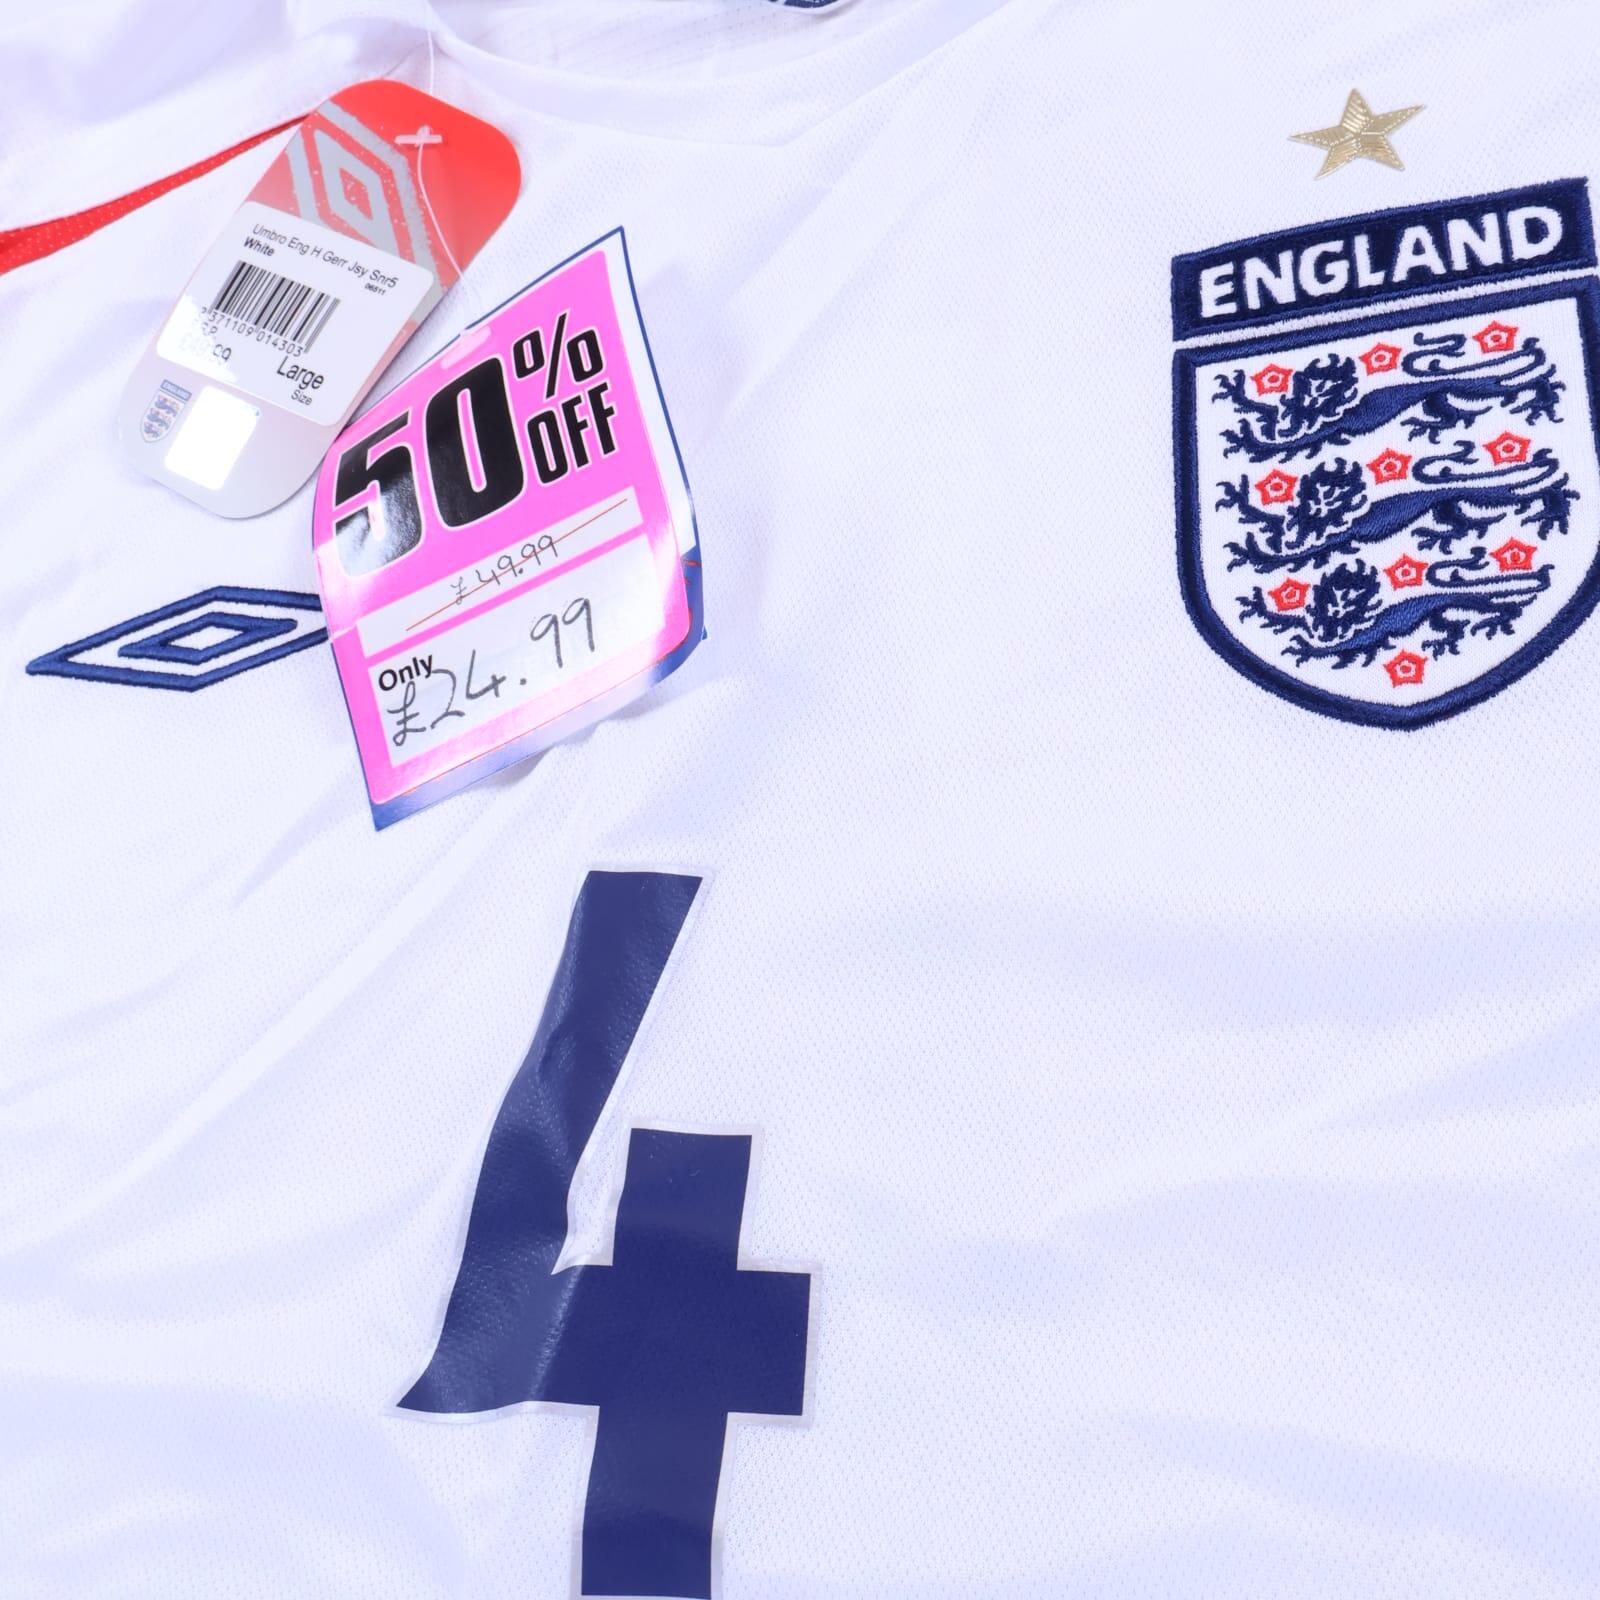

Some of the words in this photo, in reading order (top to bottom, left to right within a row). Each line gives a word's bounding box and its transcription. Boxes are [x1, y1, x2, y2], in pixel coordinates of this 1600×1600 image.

[244, 236, 275, 256] White
[252, 223, 287, 245] Umbro
[288, 237, 310, 255] Eng
[311, 247, 324, 259] H
[348, 262, 369, 277] Jsy
[369, 269, 399, 288] Snr5
[1200, 205, 1563, 319] ENGLAND
[277, 356, 325, 391] Large
[291, 390, 313, 406] Size
[527, 382, 617, 485] OFF
[449, 534, 558, 603] £49.99
[377, 653, 433, 692] Only
[387, 598, 596, 747] £24.99
[395, 870, 812, 1598] 4
